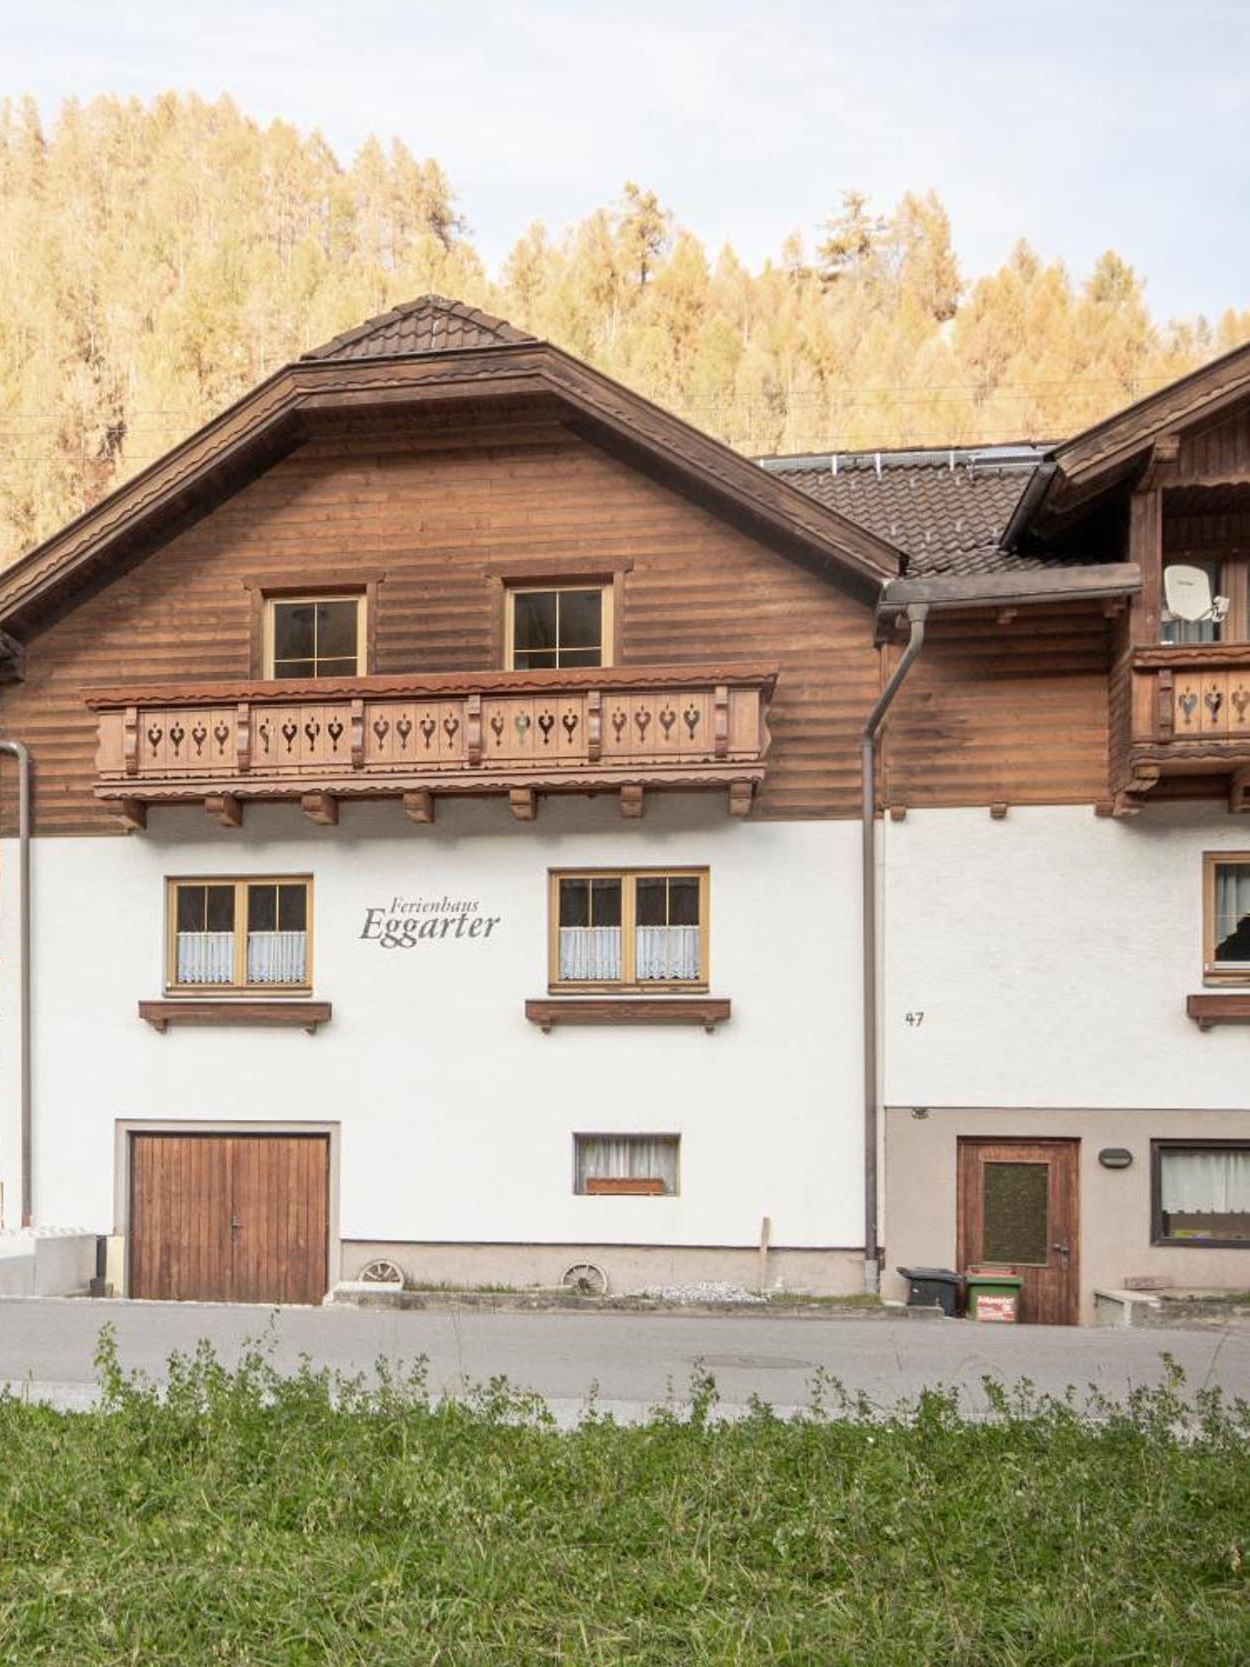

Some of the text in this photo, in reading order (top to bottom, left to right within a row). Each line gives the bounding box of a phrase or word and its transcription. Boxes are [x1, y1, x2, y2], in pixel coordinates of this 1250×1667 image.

[390, 896, 479, 913] Ferienhaus
[358, 908, 501, 949] Eggarter
[905, 1011, 924, 1028] 47
